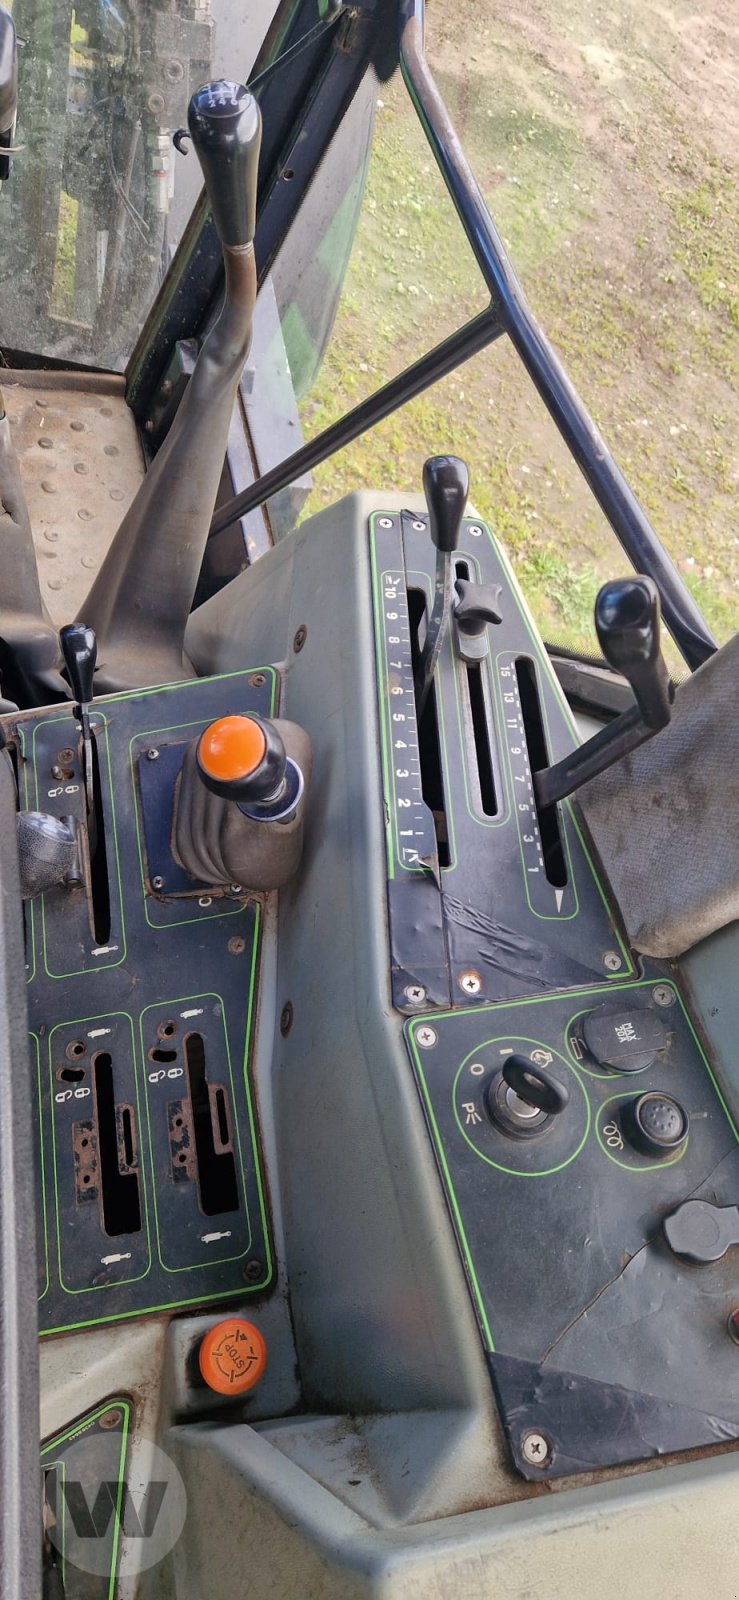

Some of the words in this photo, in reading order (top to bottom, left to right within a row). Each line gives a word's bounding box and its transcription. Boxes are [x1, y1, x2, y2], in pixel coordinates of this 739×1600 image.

[208, 100, 216, 108] 2
[219, 98, 226, 106] 4
[385, 586, 396, 599] 10
[387, 612, 398, 621] 9
[388, 636, 400, 645] 8
[390, 661, 402, 669] 7
[500, 666, 511, 677] 15
[391, 687, 403, 696] 6
[503, 692, 514, 703] 13
[393, 713, 405, 722] 5
[507, 718, 517, 729] 11
[395, 740, 407, 749] 4
[511, 746, 521, 755] 9
[396, 768, 409, 778] 3
[515, 774, 525, 783] 7
[398, 798, 411, 808] 2
[519, 803, 529, 812] 5
[400, 829, 413, 837] 1
[523, 834, 534, 843] 3
[622, 1022, 637, 1042] MAX
[225, 1344, 245, 1369] STOP
